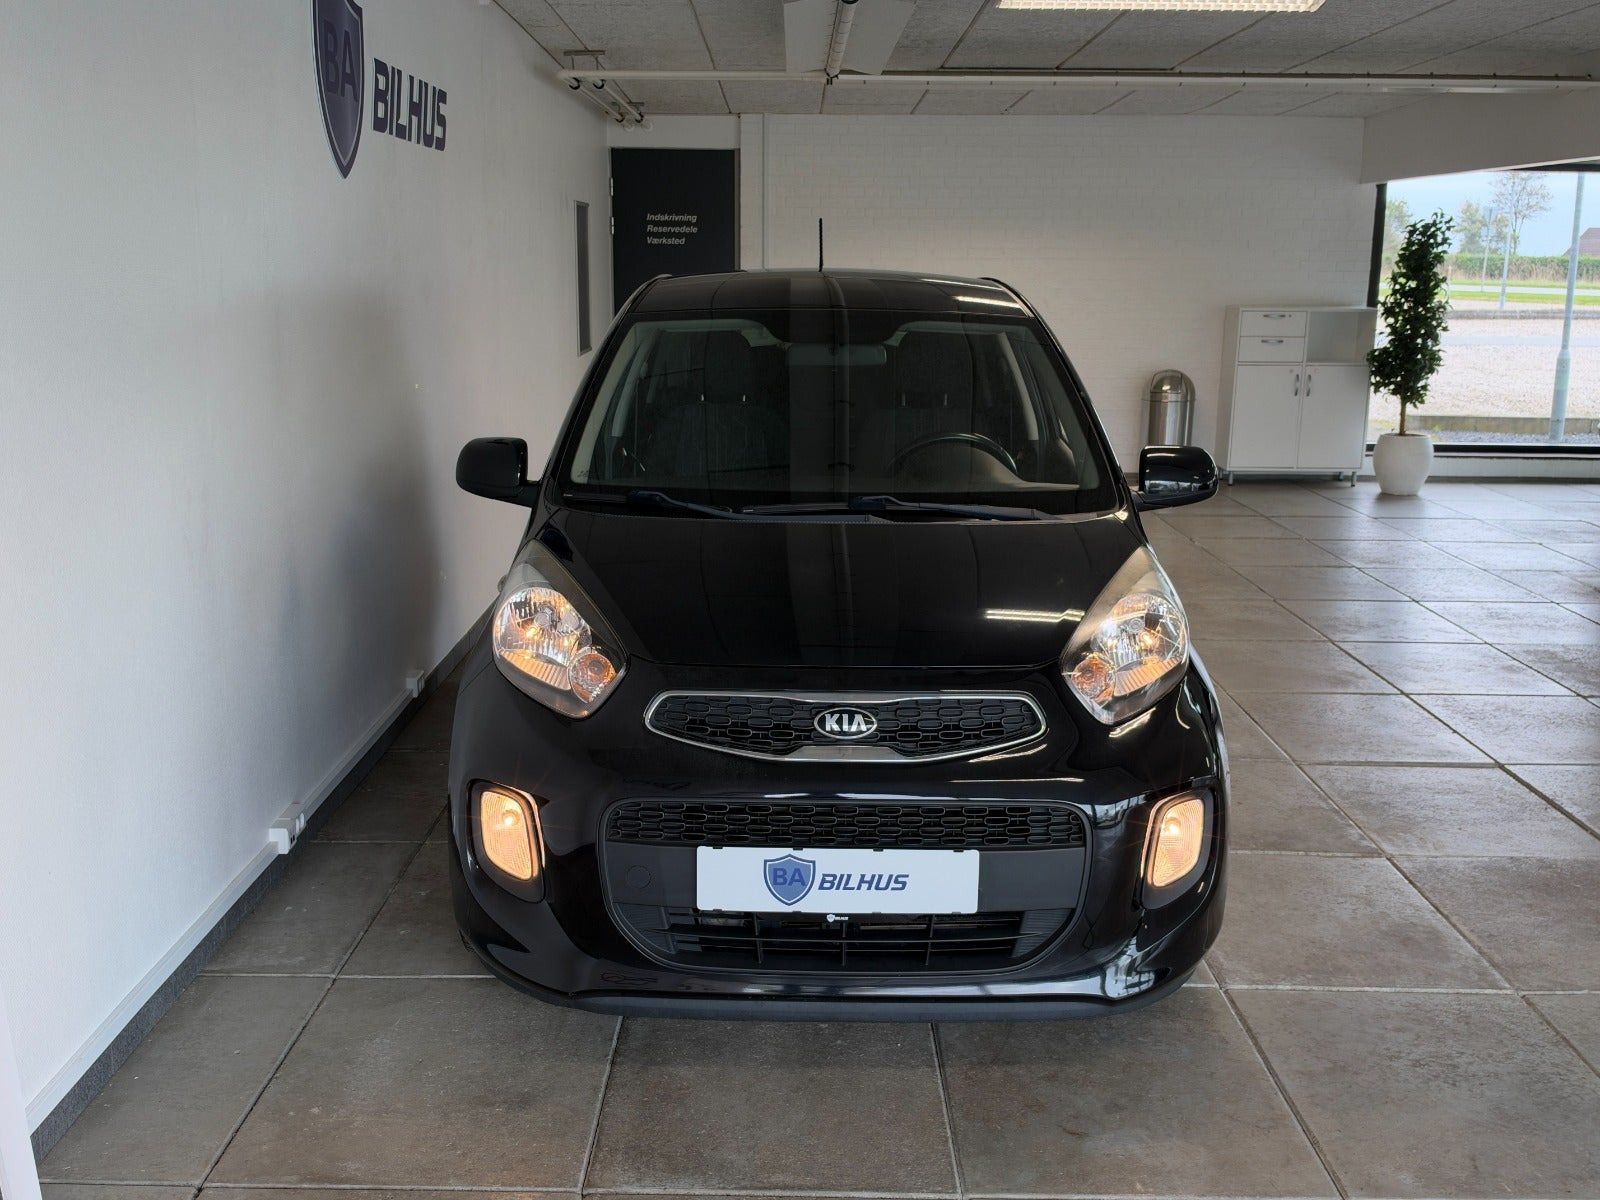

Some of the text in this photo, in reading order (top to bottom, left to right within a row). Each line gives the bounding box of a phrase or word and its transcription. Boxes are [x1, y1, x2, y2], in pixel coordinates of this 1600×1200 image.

[372, 57, 448, 152] BILHUS
[646, 213, 698, 223] Indskrivning
[646, 224, 698, 233] Reservedele
[646, 236, 686, 245] Værksted
[824, 713, 868, 732] KIA
[772, 867, 910, 891] BA BILHUS
